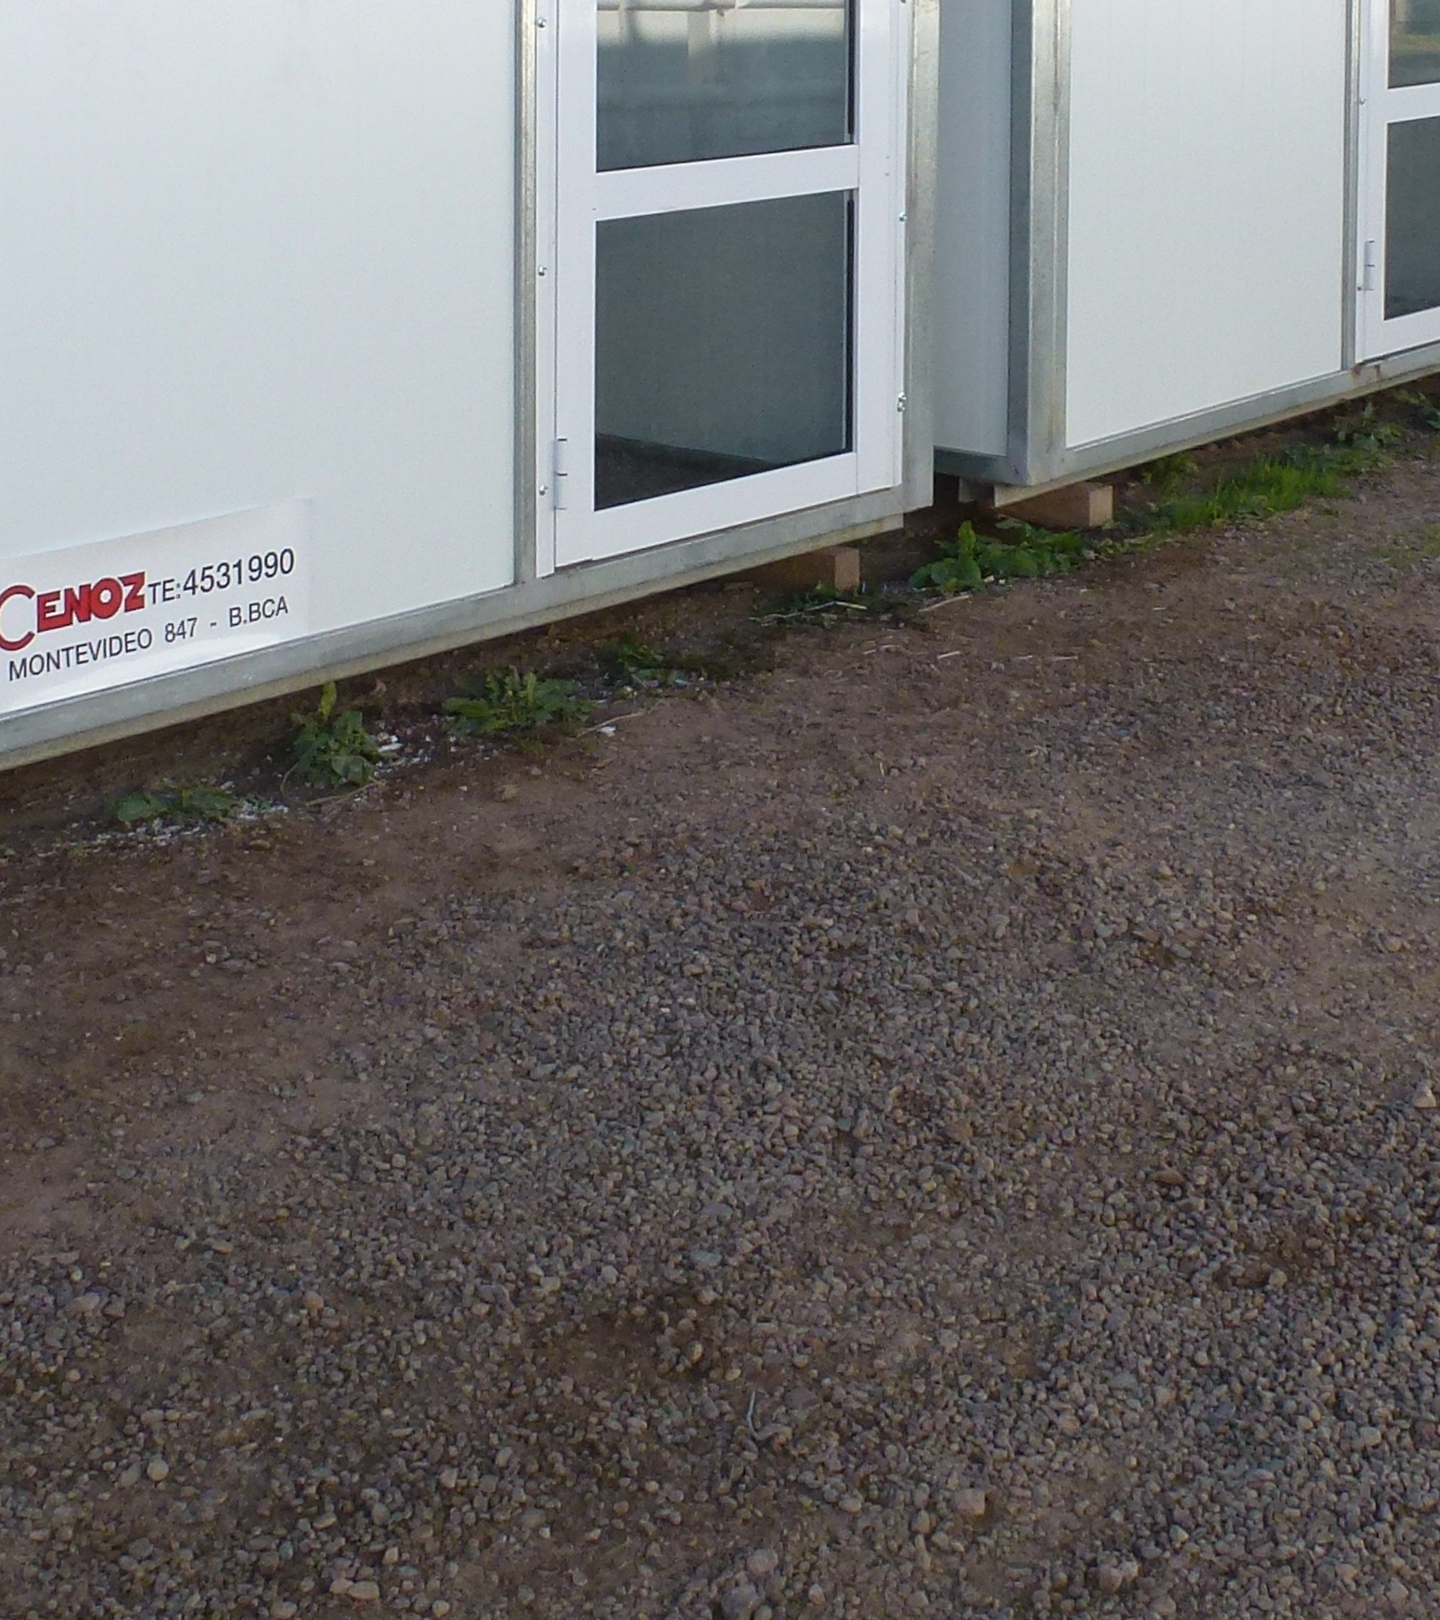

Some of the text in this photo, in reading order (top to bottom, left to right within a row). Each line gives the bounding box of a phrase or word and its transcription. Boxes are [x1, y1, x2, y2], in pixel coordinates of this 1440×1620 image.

[8, 629, 153, 682] MONTEVIDEO
[164, 617, 198, 643] 847
[229, 596, 289, 628] B.BCA
